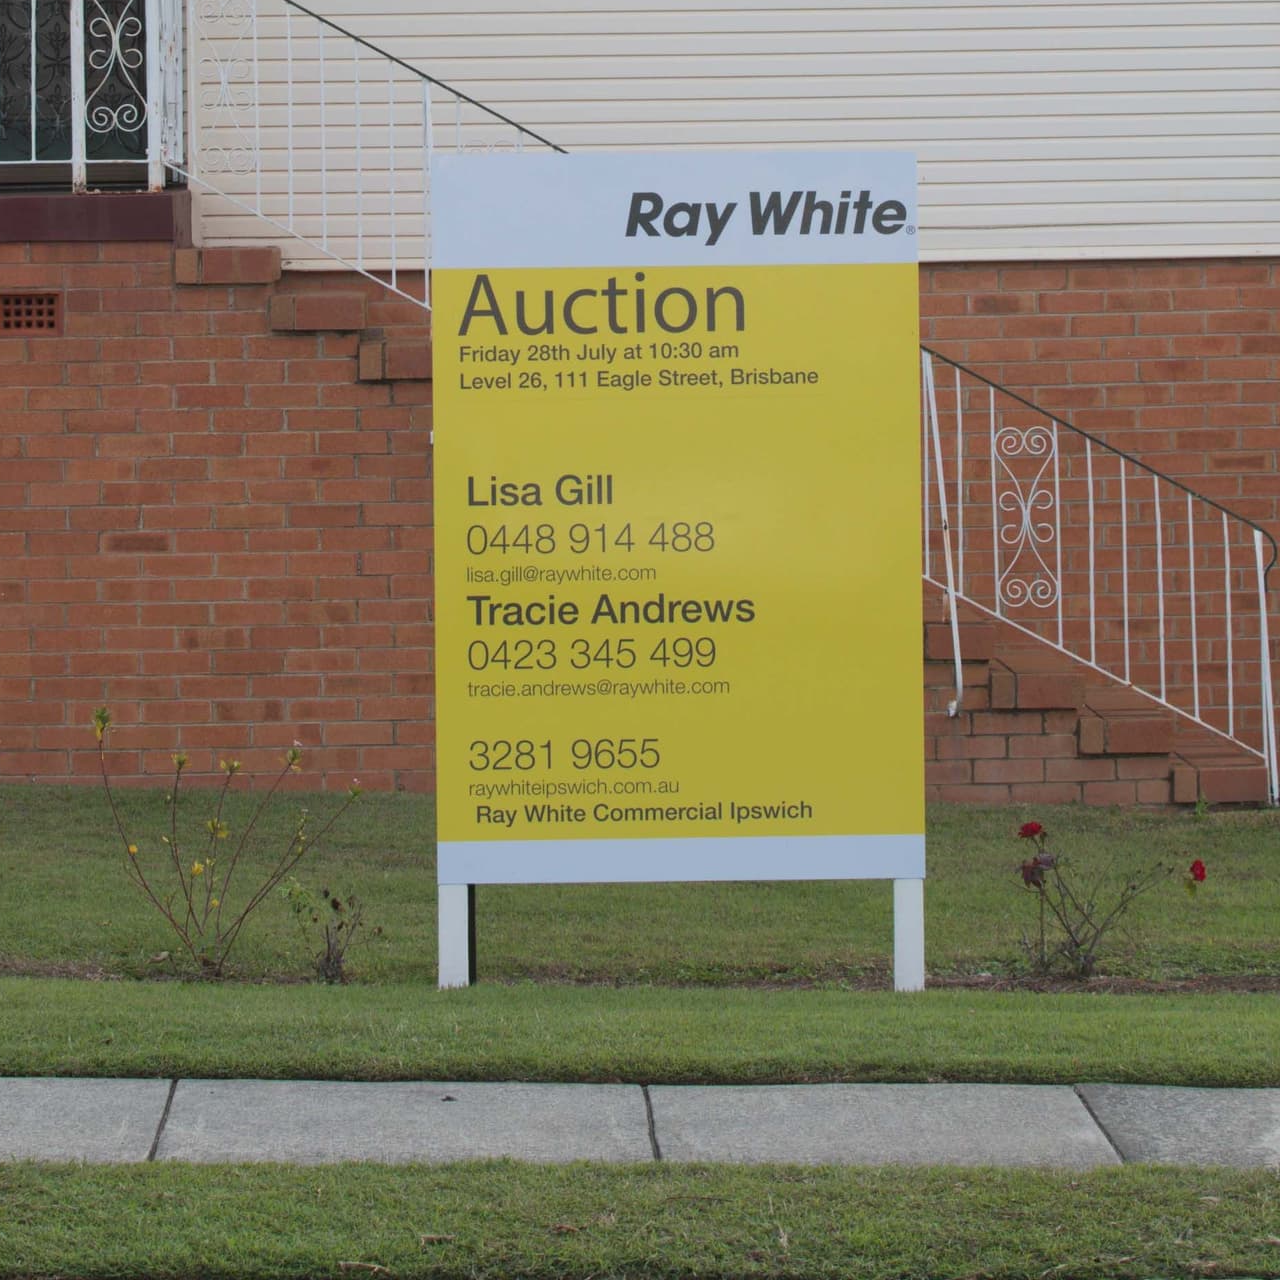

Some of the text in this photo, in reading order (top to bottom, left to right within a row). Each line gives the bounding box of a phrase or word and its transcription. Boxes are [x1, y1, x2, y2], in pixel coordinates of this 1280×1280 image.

[624, 189, 908, 247] Ray White
[457, 271, 745, 337] Auction
[459, 341, 740, 367] Friday 28th July at 10:30 am
[459, 367, 819, 392] Level 26, 111 Eagle Street, Brisbane
[467, 473, 613, 507] Lisa Gill
[466, 521, 715, 556] 0448 914 488
[466, 565, 657, 587] lisa.gill@raywhite.com
[466, 592, 756, 627] Tracie Andrews
[467, 636, 717, 671] 0423 345 499
[467, 678, 730, 699] tracie.andrews@raywhite.com
[468, 737, 661, 772] 3281 9655
[468, 777, 680, 800] raywhiteipswich.com.au
[476, 800, 813, 828] Ray White Commercial Ipswich
